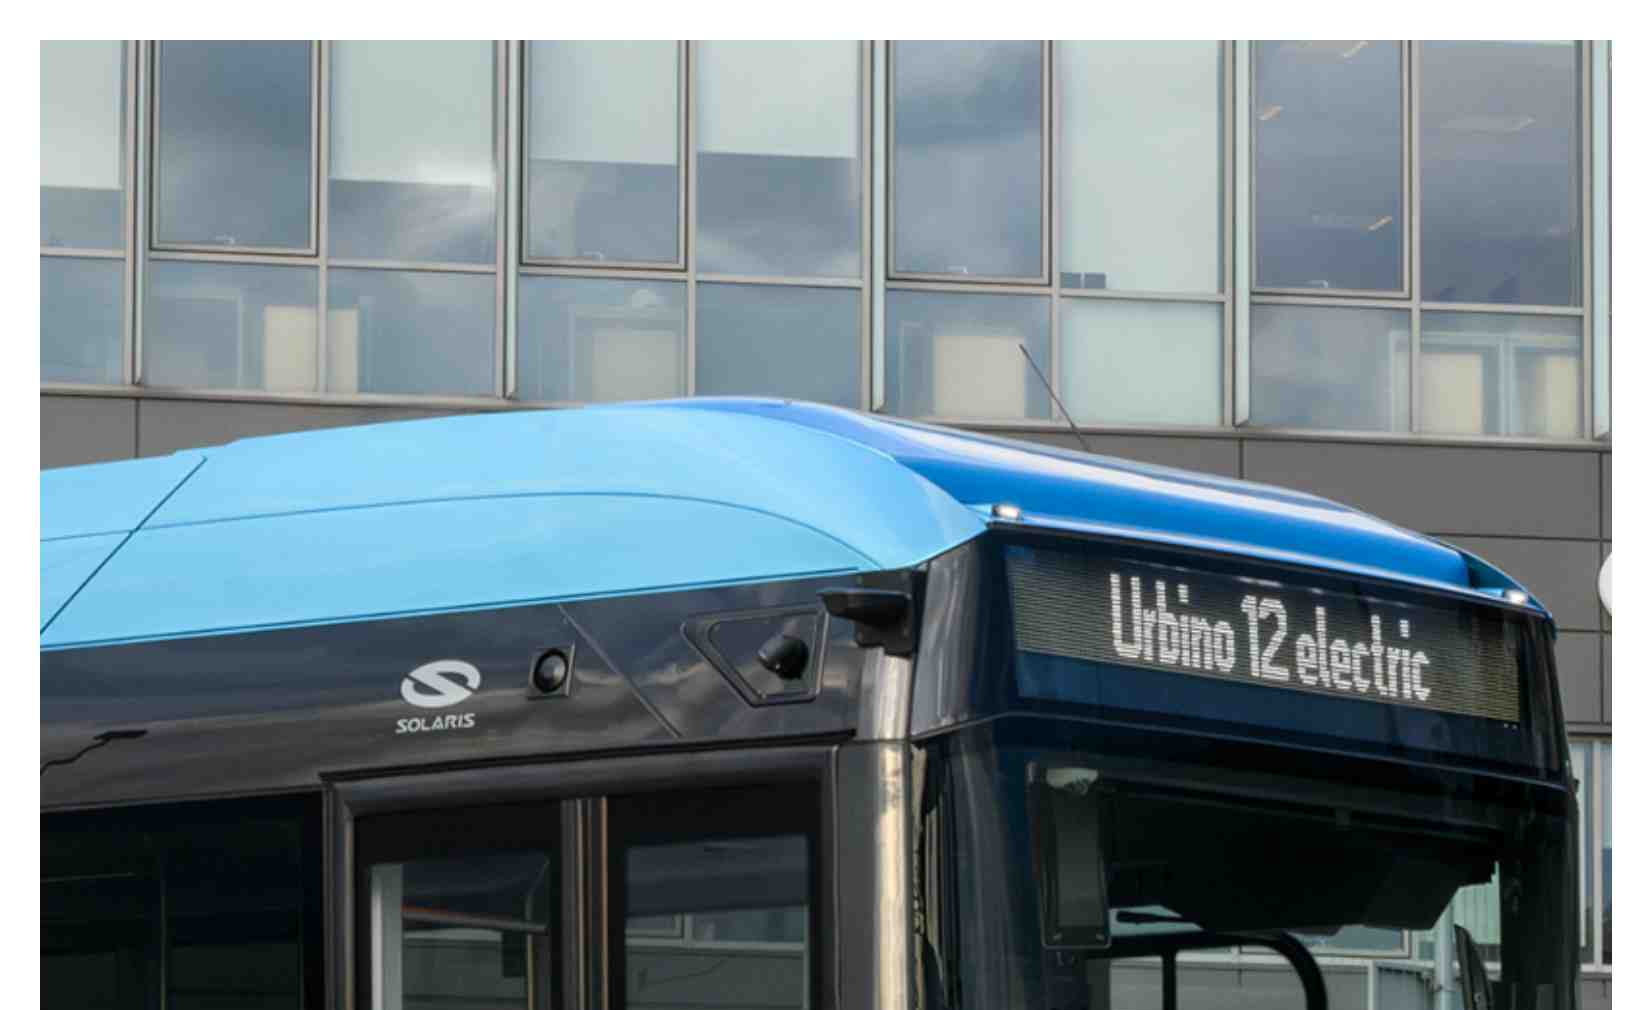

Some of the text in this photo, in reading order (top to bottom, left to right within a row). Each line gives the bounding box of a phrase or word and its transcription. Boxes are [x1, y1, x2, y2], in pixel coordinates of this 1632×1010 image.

[1110, 572, 1431, 701] Urbino 12 electric
[395, 712, 476, 734] SOLARIS
